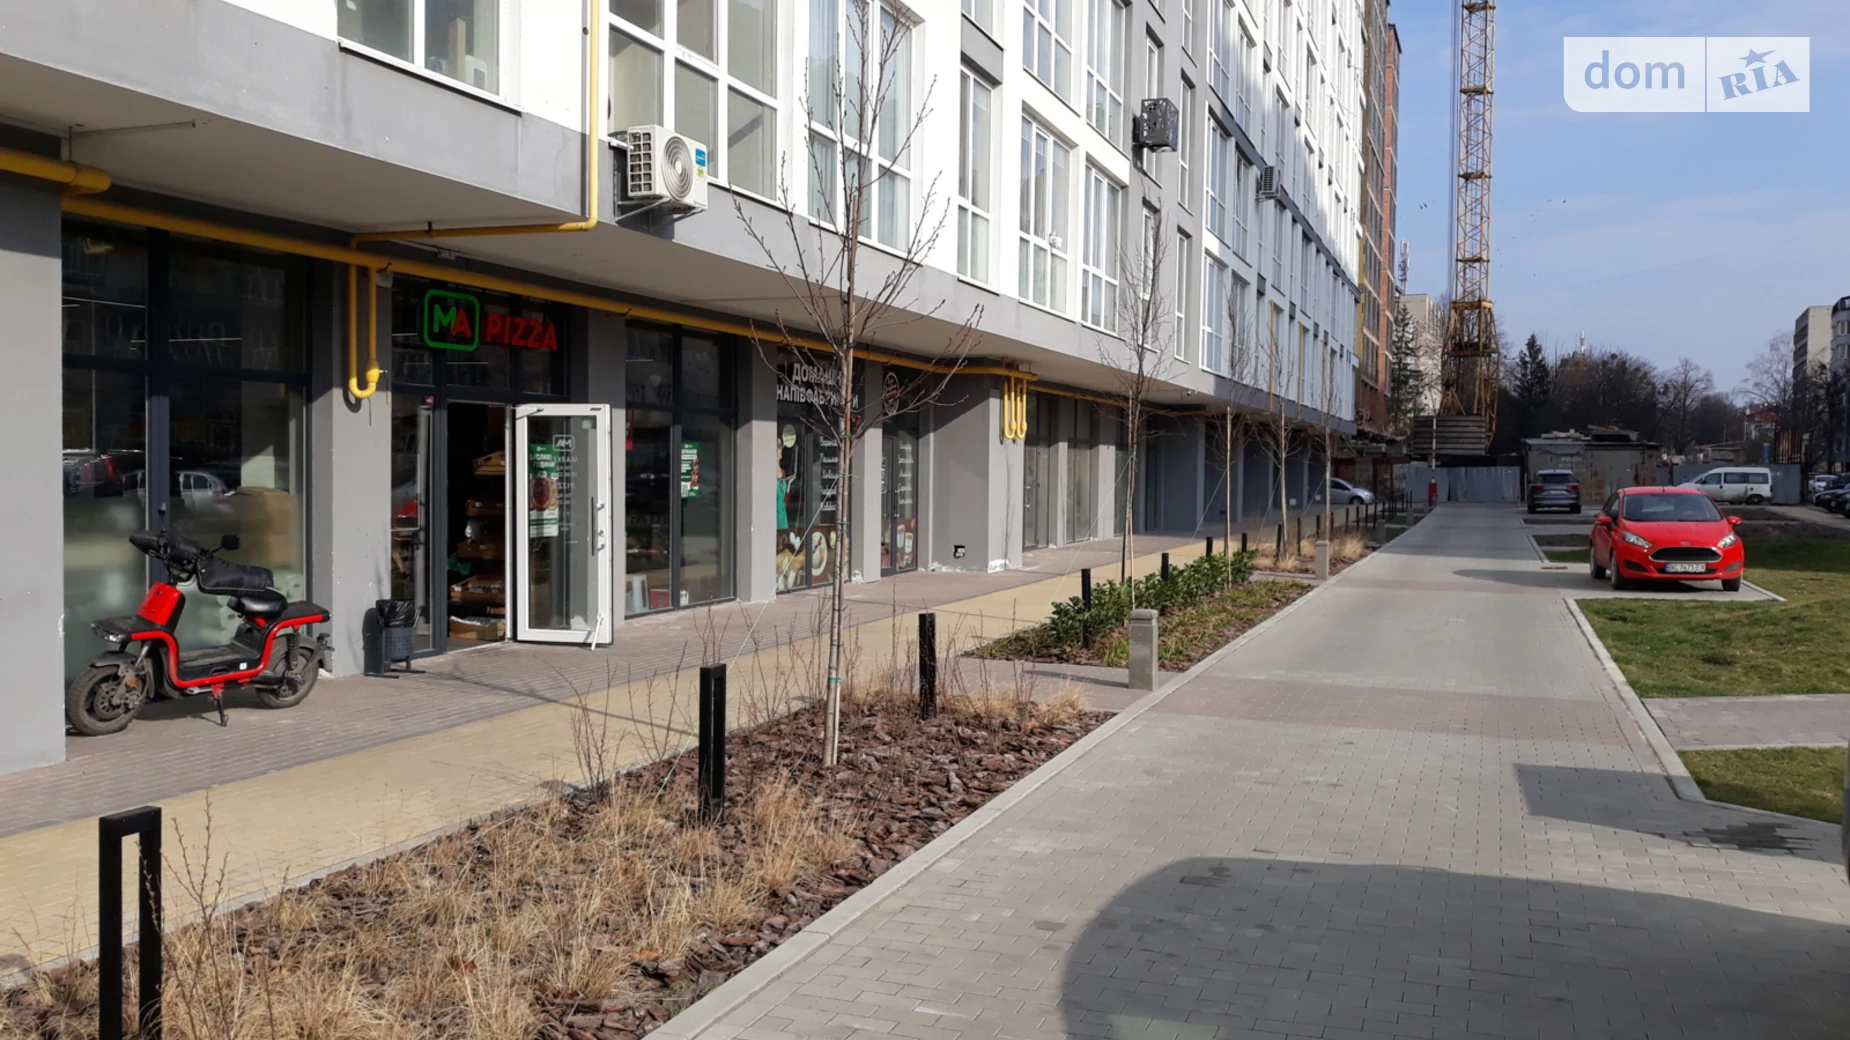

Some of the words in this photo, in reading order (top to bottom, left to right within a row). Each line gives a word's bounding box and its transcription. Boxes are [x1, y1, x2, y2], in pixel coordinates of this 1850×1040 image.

[432, 303, 472, 338] MA
[485, 312, 558, 351] PIZZA
[792, 362, 844, 386] ДОМАШН
